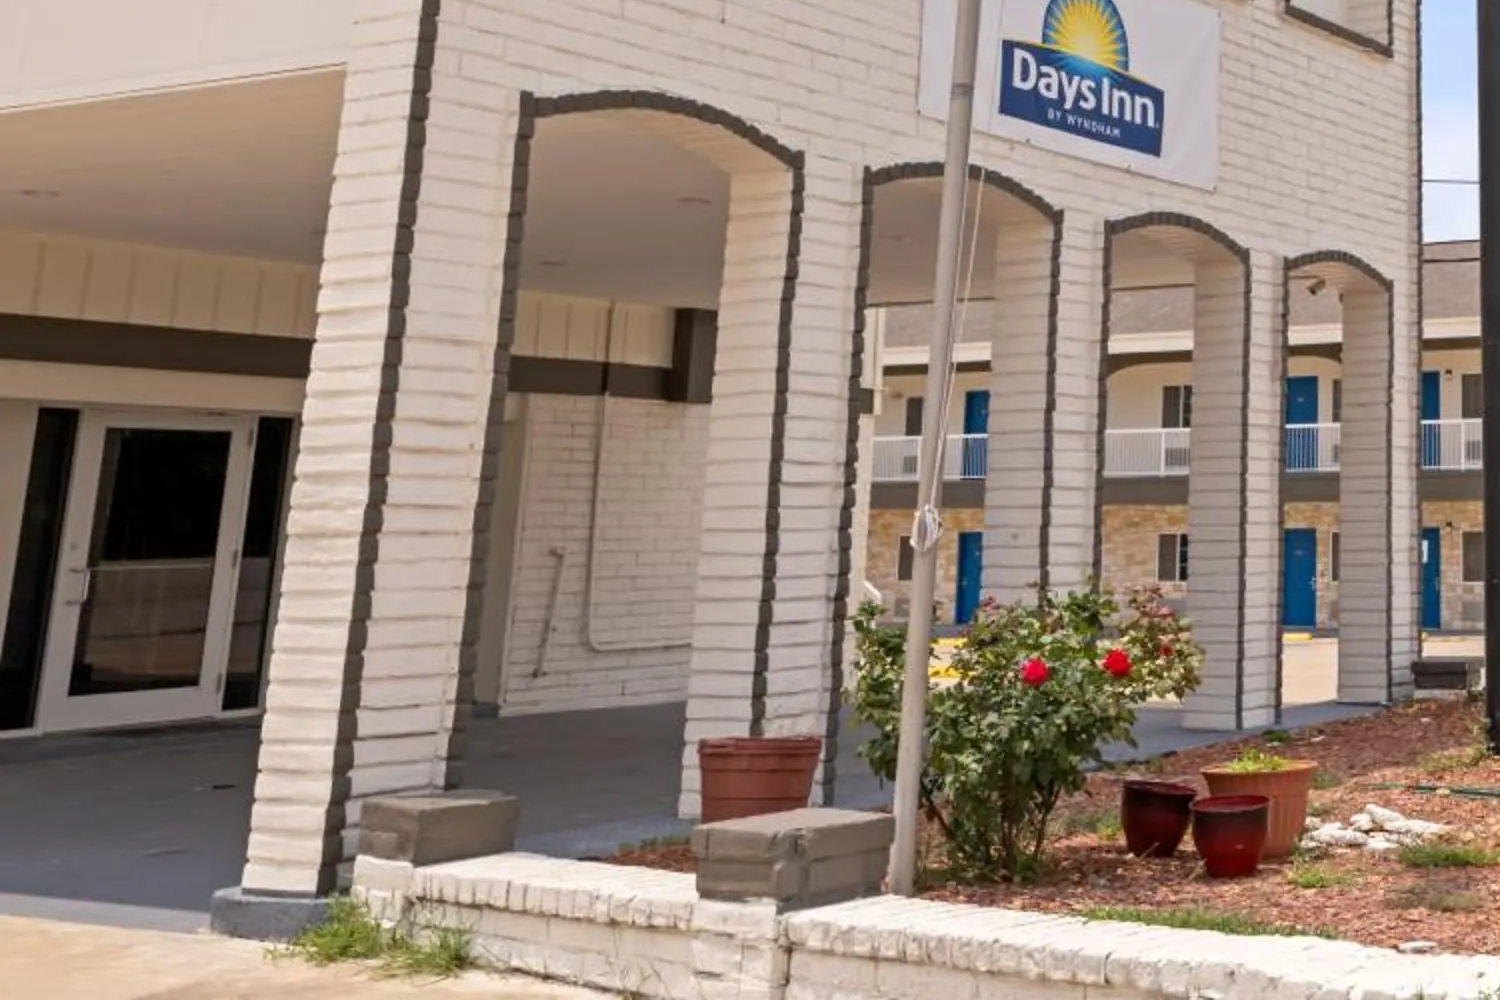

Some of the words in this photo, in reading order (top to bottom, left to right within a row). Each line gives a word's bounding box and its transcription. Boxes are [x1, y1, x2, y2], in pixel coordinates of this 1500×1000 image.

[1012, 47, 1097, 110] Days
[1101, 76, 1155, 129] Inn
[1067, 115, 1121, 137] WYNDHAM
